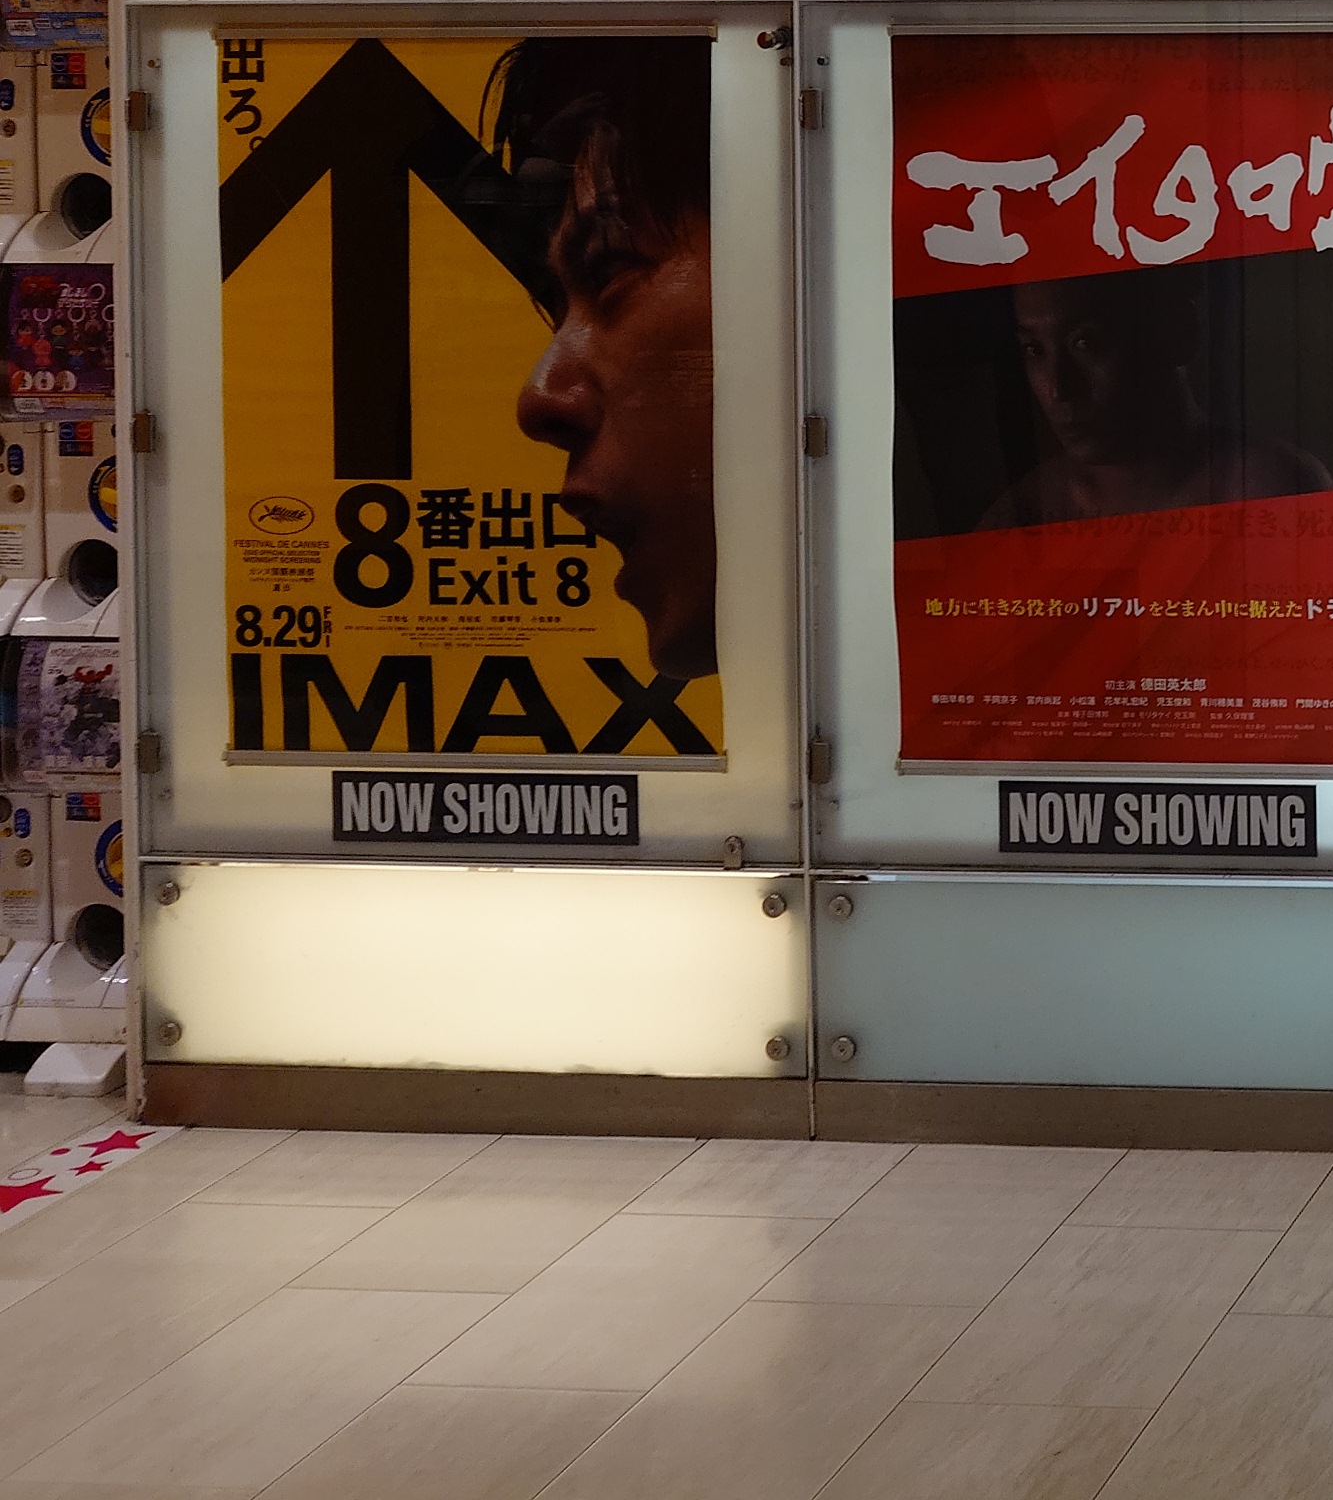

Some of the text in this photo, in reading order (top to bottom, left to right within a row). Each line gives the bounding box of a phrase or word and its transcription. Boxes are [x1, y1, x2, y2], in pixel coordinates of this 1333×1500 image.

[429, 557, 590, 607] Exit 8
[235, 604, 321, 648] 8.29
[231, 654, 718, 754] IMAX
[341, 781, 629, 837] NOW SHOWING
[1008, 791, 1306, 847] NOW SHOWING
